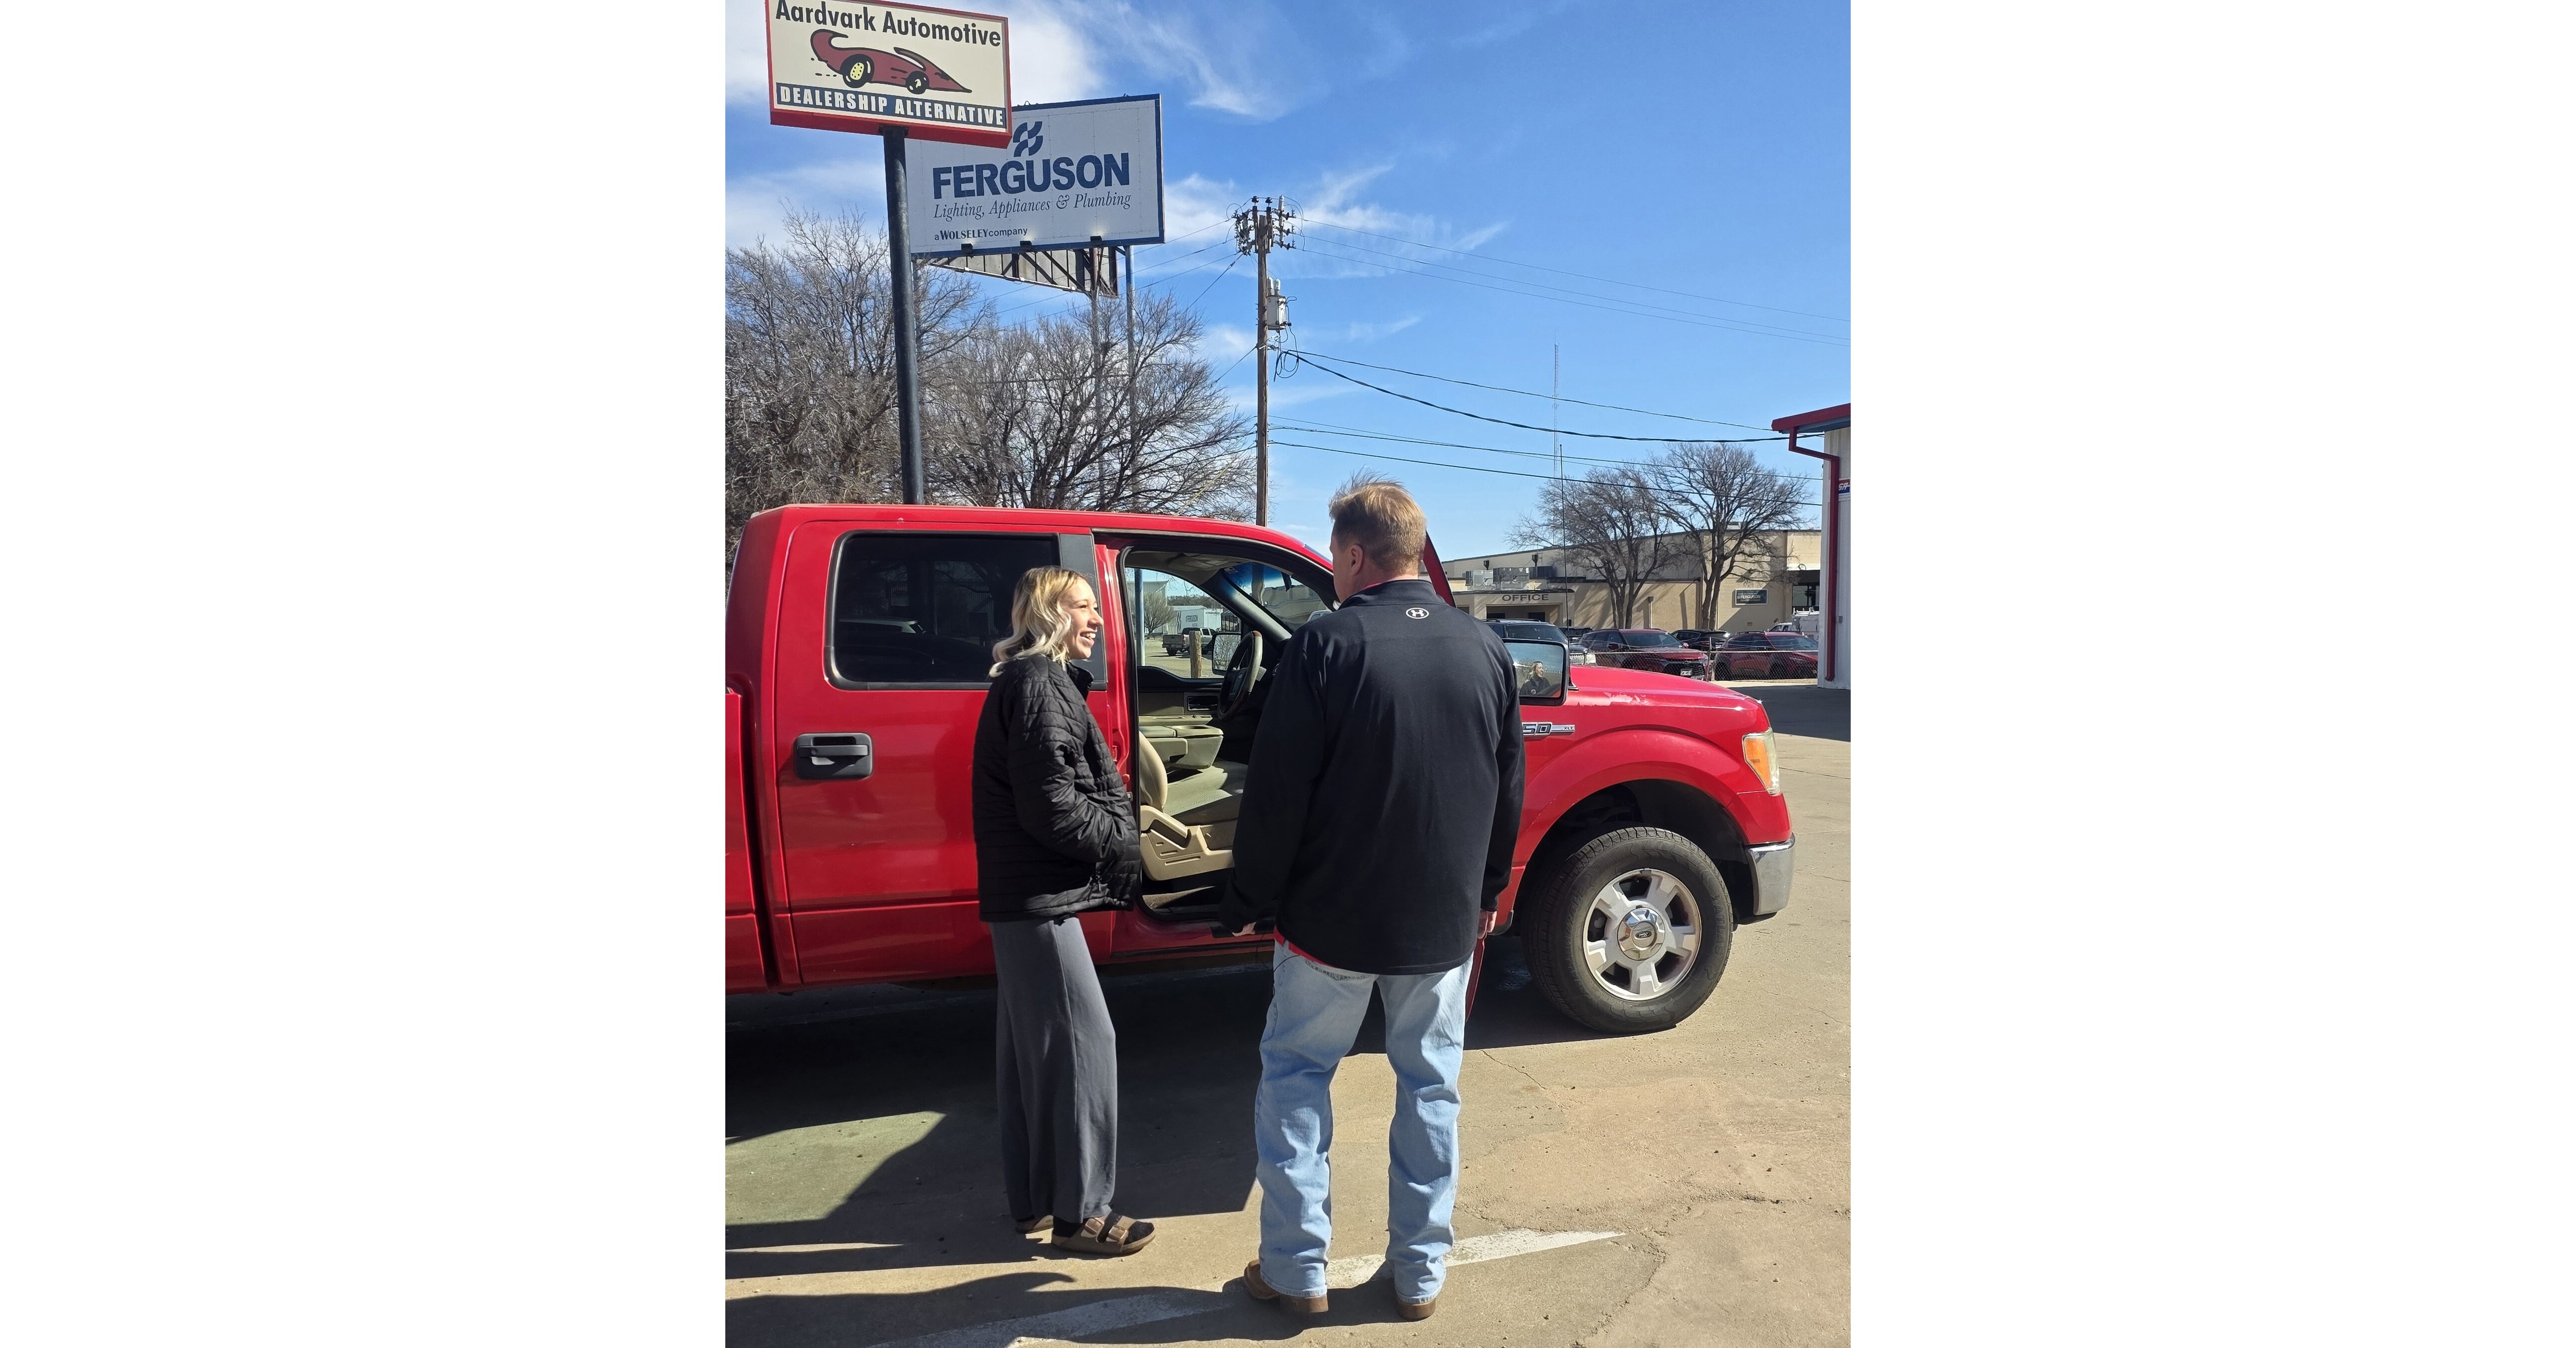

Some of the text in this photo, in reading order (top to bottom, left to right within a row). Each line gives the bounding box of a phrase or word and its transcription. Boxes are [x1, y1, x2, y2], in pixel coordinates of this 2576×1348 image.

[776, 0, 1001, 46] Aardvark Automotive
[780, 86, 1004, 125] DEALERSHIP ALTERNATIVE
[933, 152, 1130, 199] FERGUSON
[933, 191, 1131, 222] Lighting, Appliances & Plumbing
